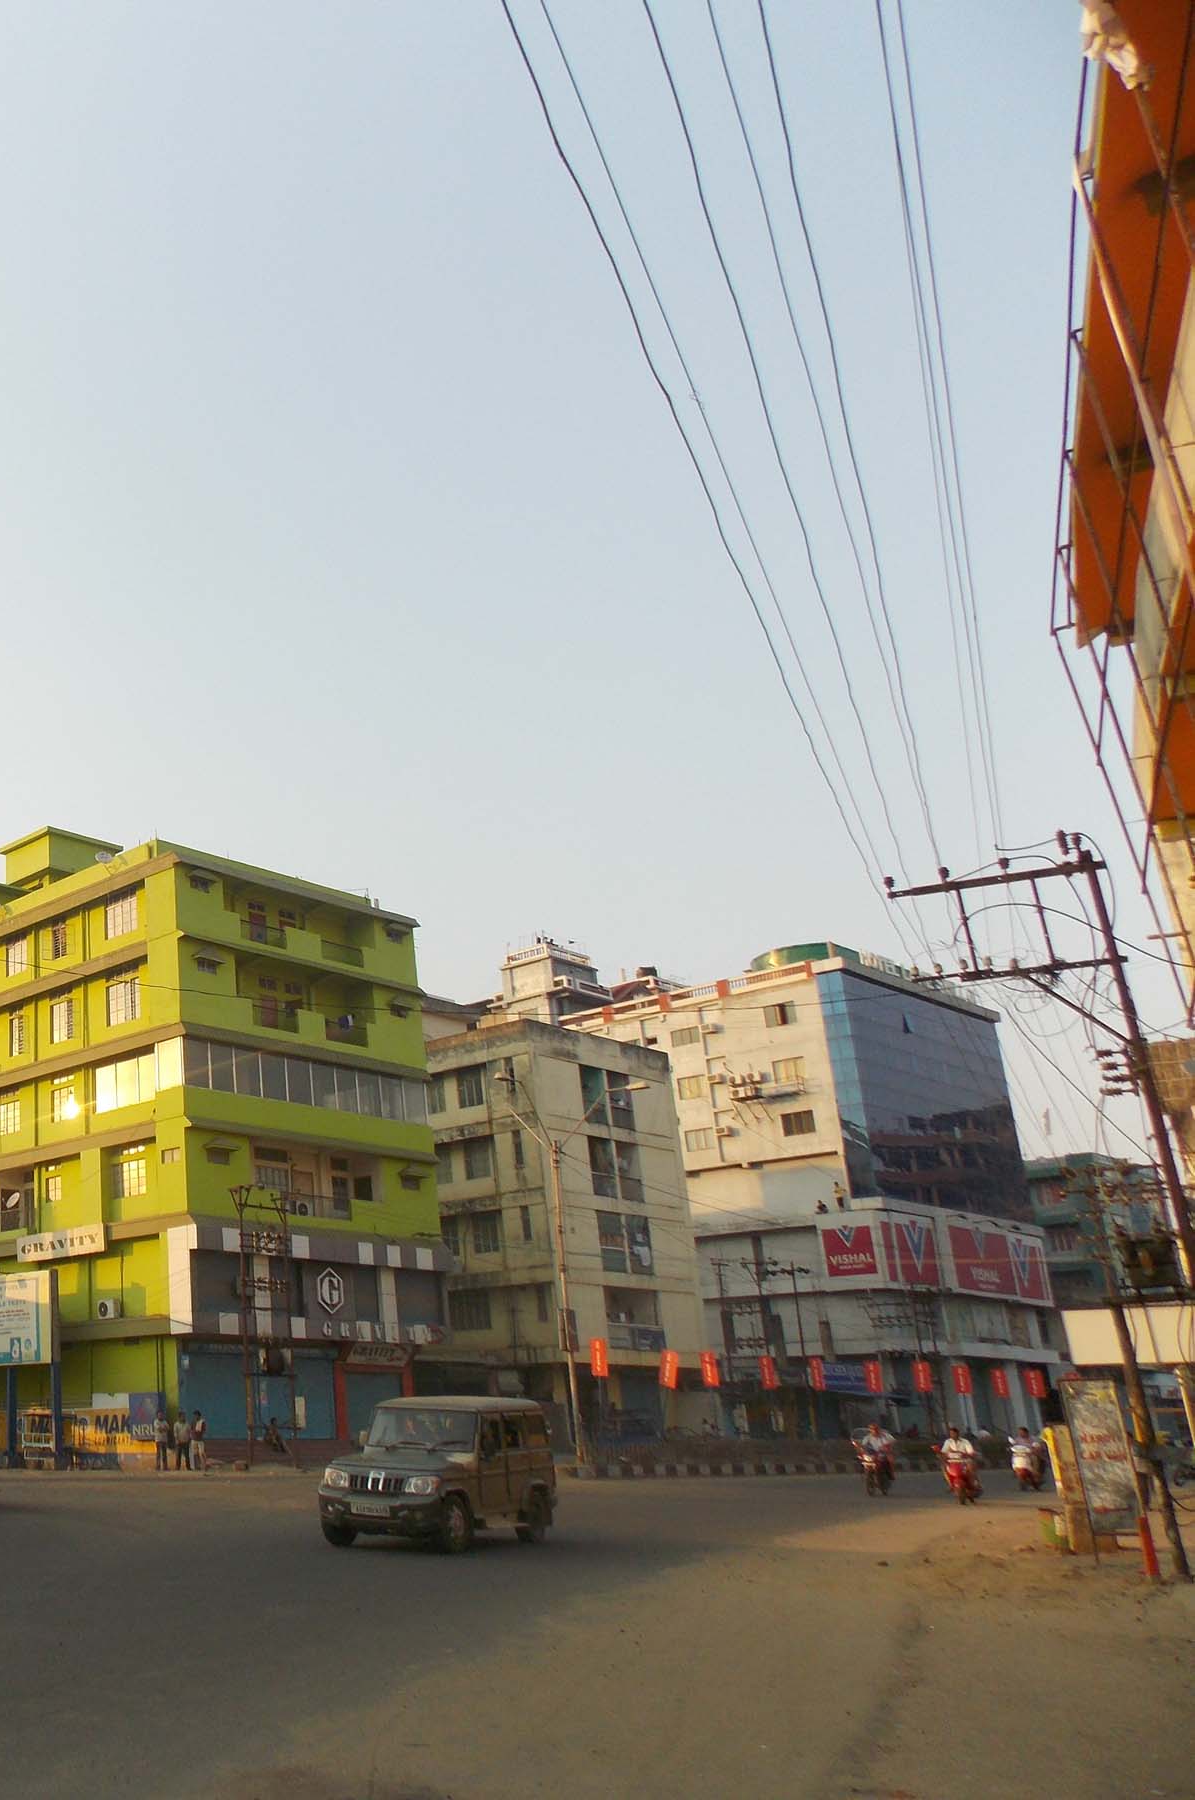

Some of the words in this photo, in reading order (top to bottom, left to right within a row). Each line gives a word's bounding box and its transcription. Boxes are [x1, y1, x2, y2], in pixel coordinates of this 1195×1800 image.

[20, 1231, 102, 1256] GRAVITY
[829, 1253, 874, 1265] VISHAL
[132, 1423, 155, 1436] NRL
